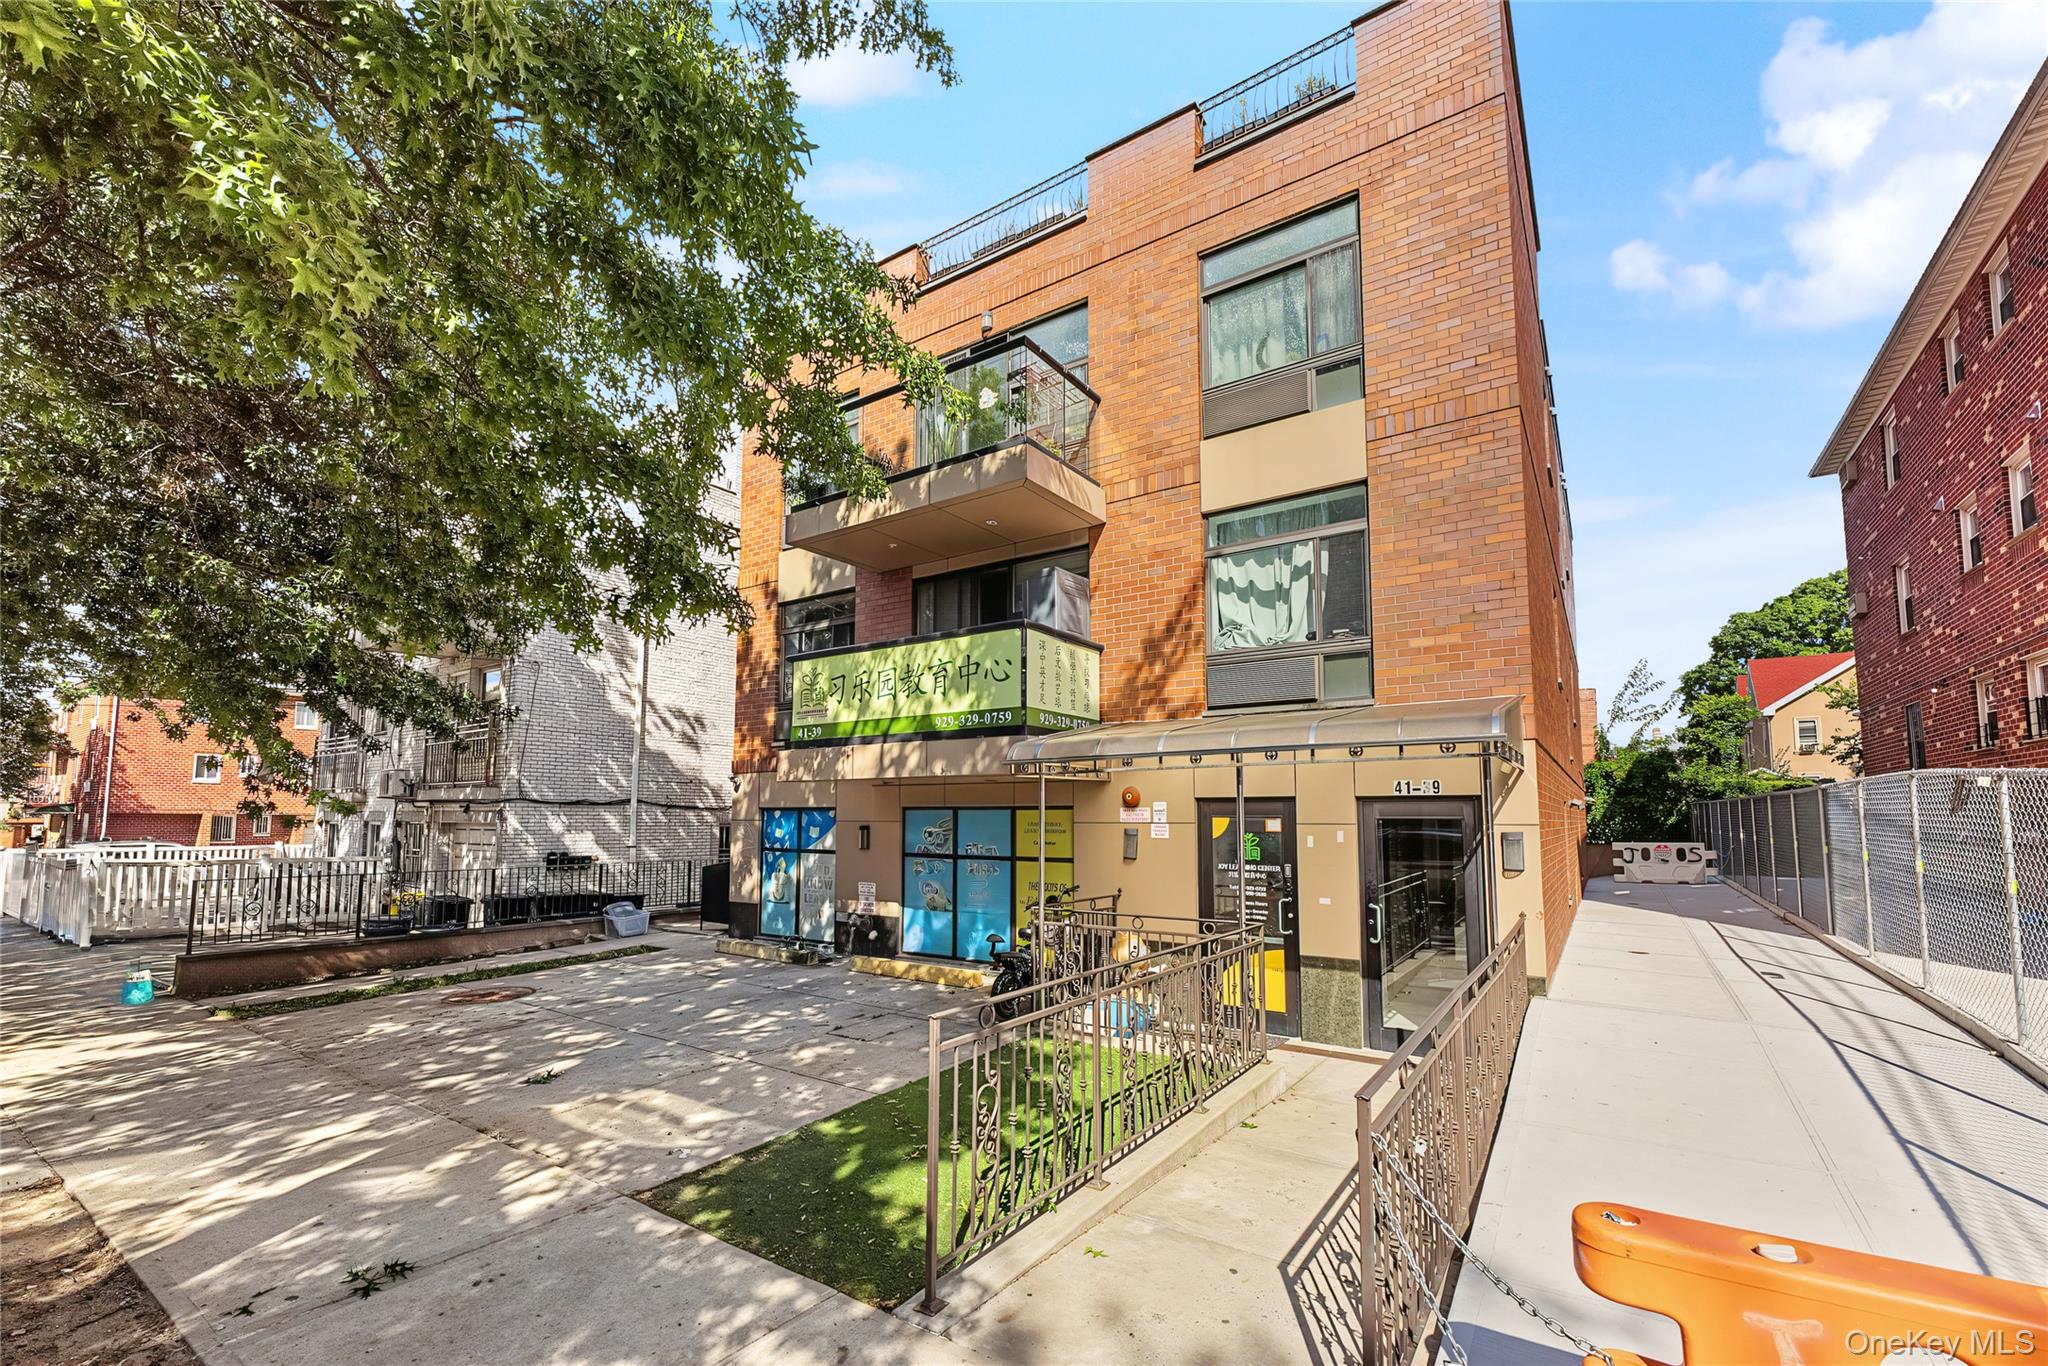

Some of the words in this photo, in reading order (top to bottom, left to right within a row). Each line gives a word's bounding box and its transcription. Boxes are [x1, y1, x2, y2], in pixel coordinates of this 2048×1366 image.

[829, 654, 1012, 705] 习乐园教育中心
[935, 711, 1012, 728] 929-329-0759
[797, 727, 822, 739] 41-39
